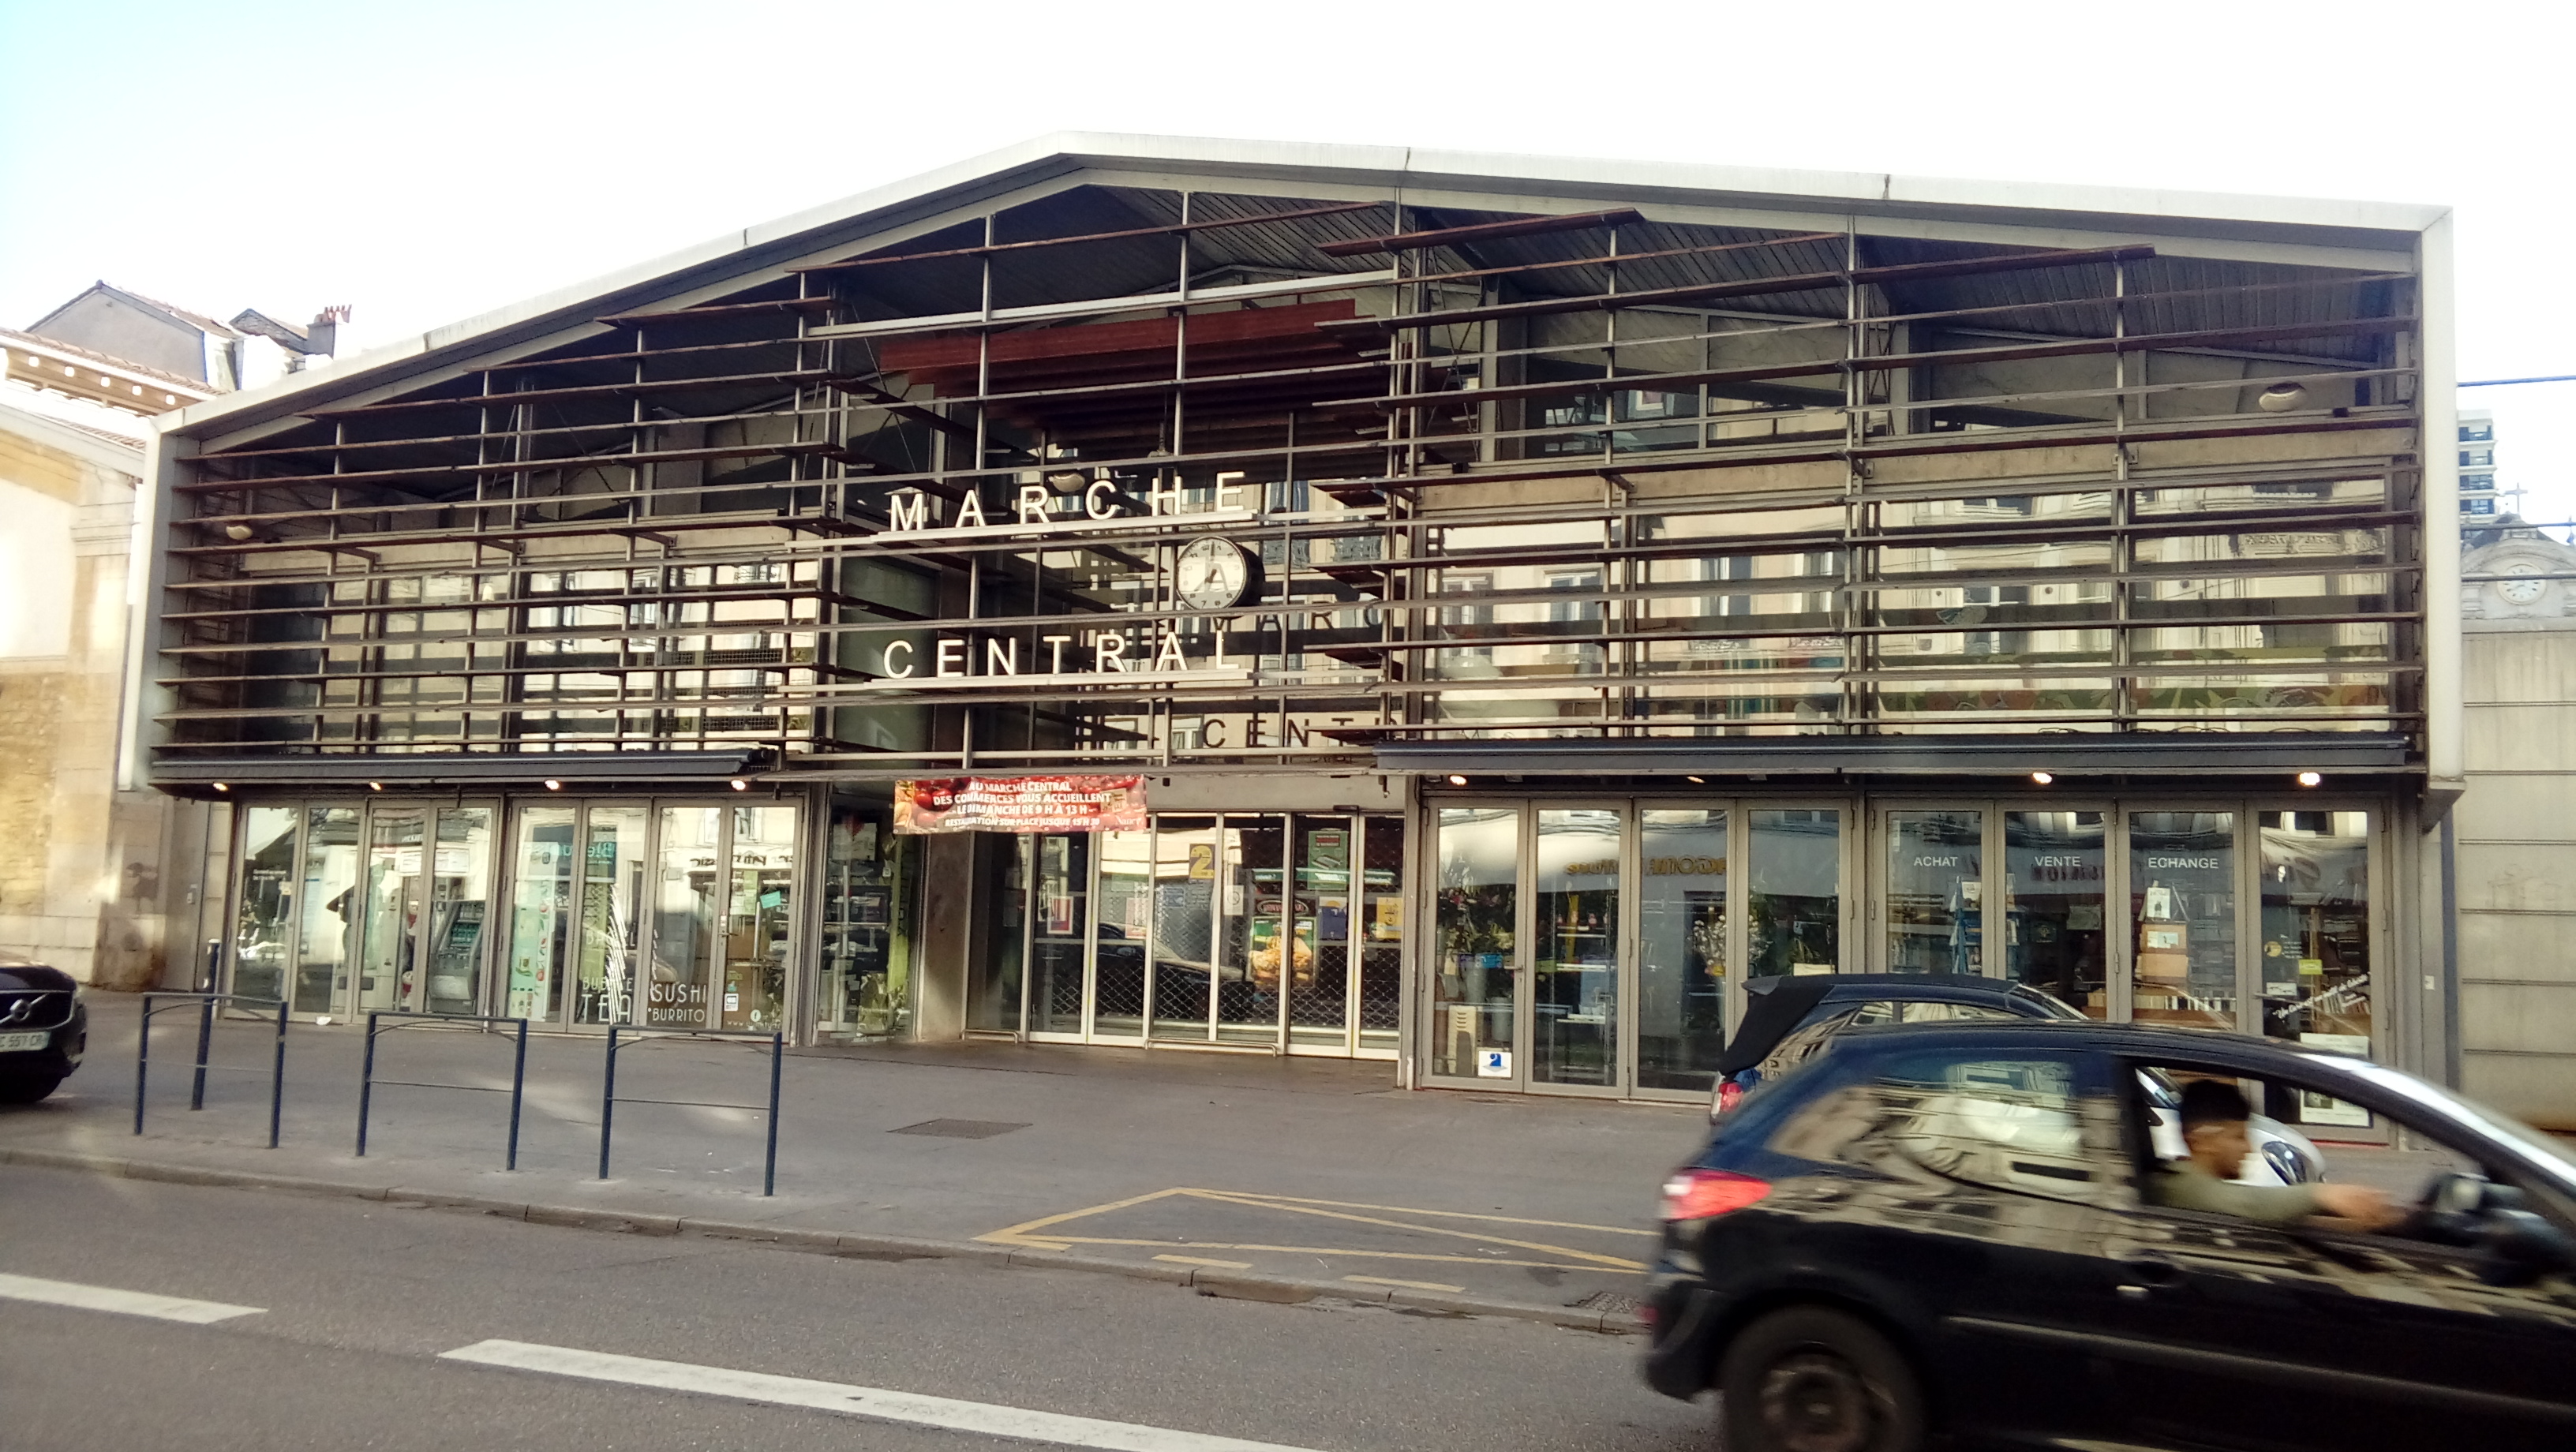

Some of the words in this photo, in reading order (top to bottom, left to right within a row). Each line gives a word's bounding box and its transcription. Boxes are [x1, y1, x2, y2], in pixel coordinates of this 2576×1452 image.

[889, 471, 1248, 533] MARCHE
[883, 630, 1240, 680] CENTRAL
[968, 782, 983, 791] AU
[1027, 781, 1072, 791] CENTRAL
[932, 795, 953, 806] DES
[1016, 793, 1041, 803] VOUS
[1043, 793, 1111, 803] ACCUEILLENT
[957, 805, 967, 814] LE
[968, 805, 1020, 814] DIMANCHE
[1021, 805, 1034, 814] DE
[1035, 805, 1042, 814] 9
[1044, 805, 1053, 814] H
[1065, 805, 1076, 814] 13
[1079, 805, 1088, 814] H
[1913, 855, 1959, 867] ACHAT
[2035, 855, 2082, 867] VENTE
[2147, 857, 2220, 870] ECHANGE
[653, 983, 707, 1004] SUSHI
[652, 1008, 706, 1023] BURRITO
